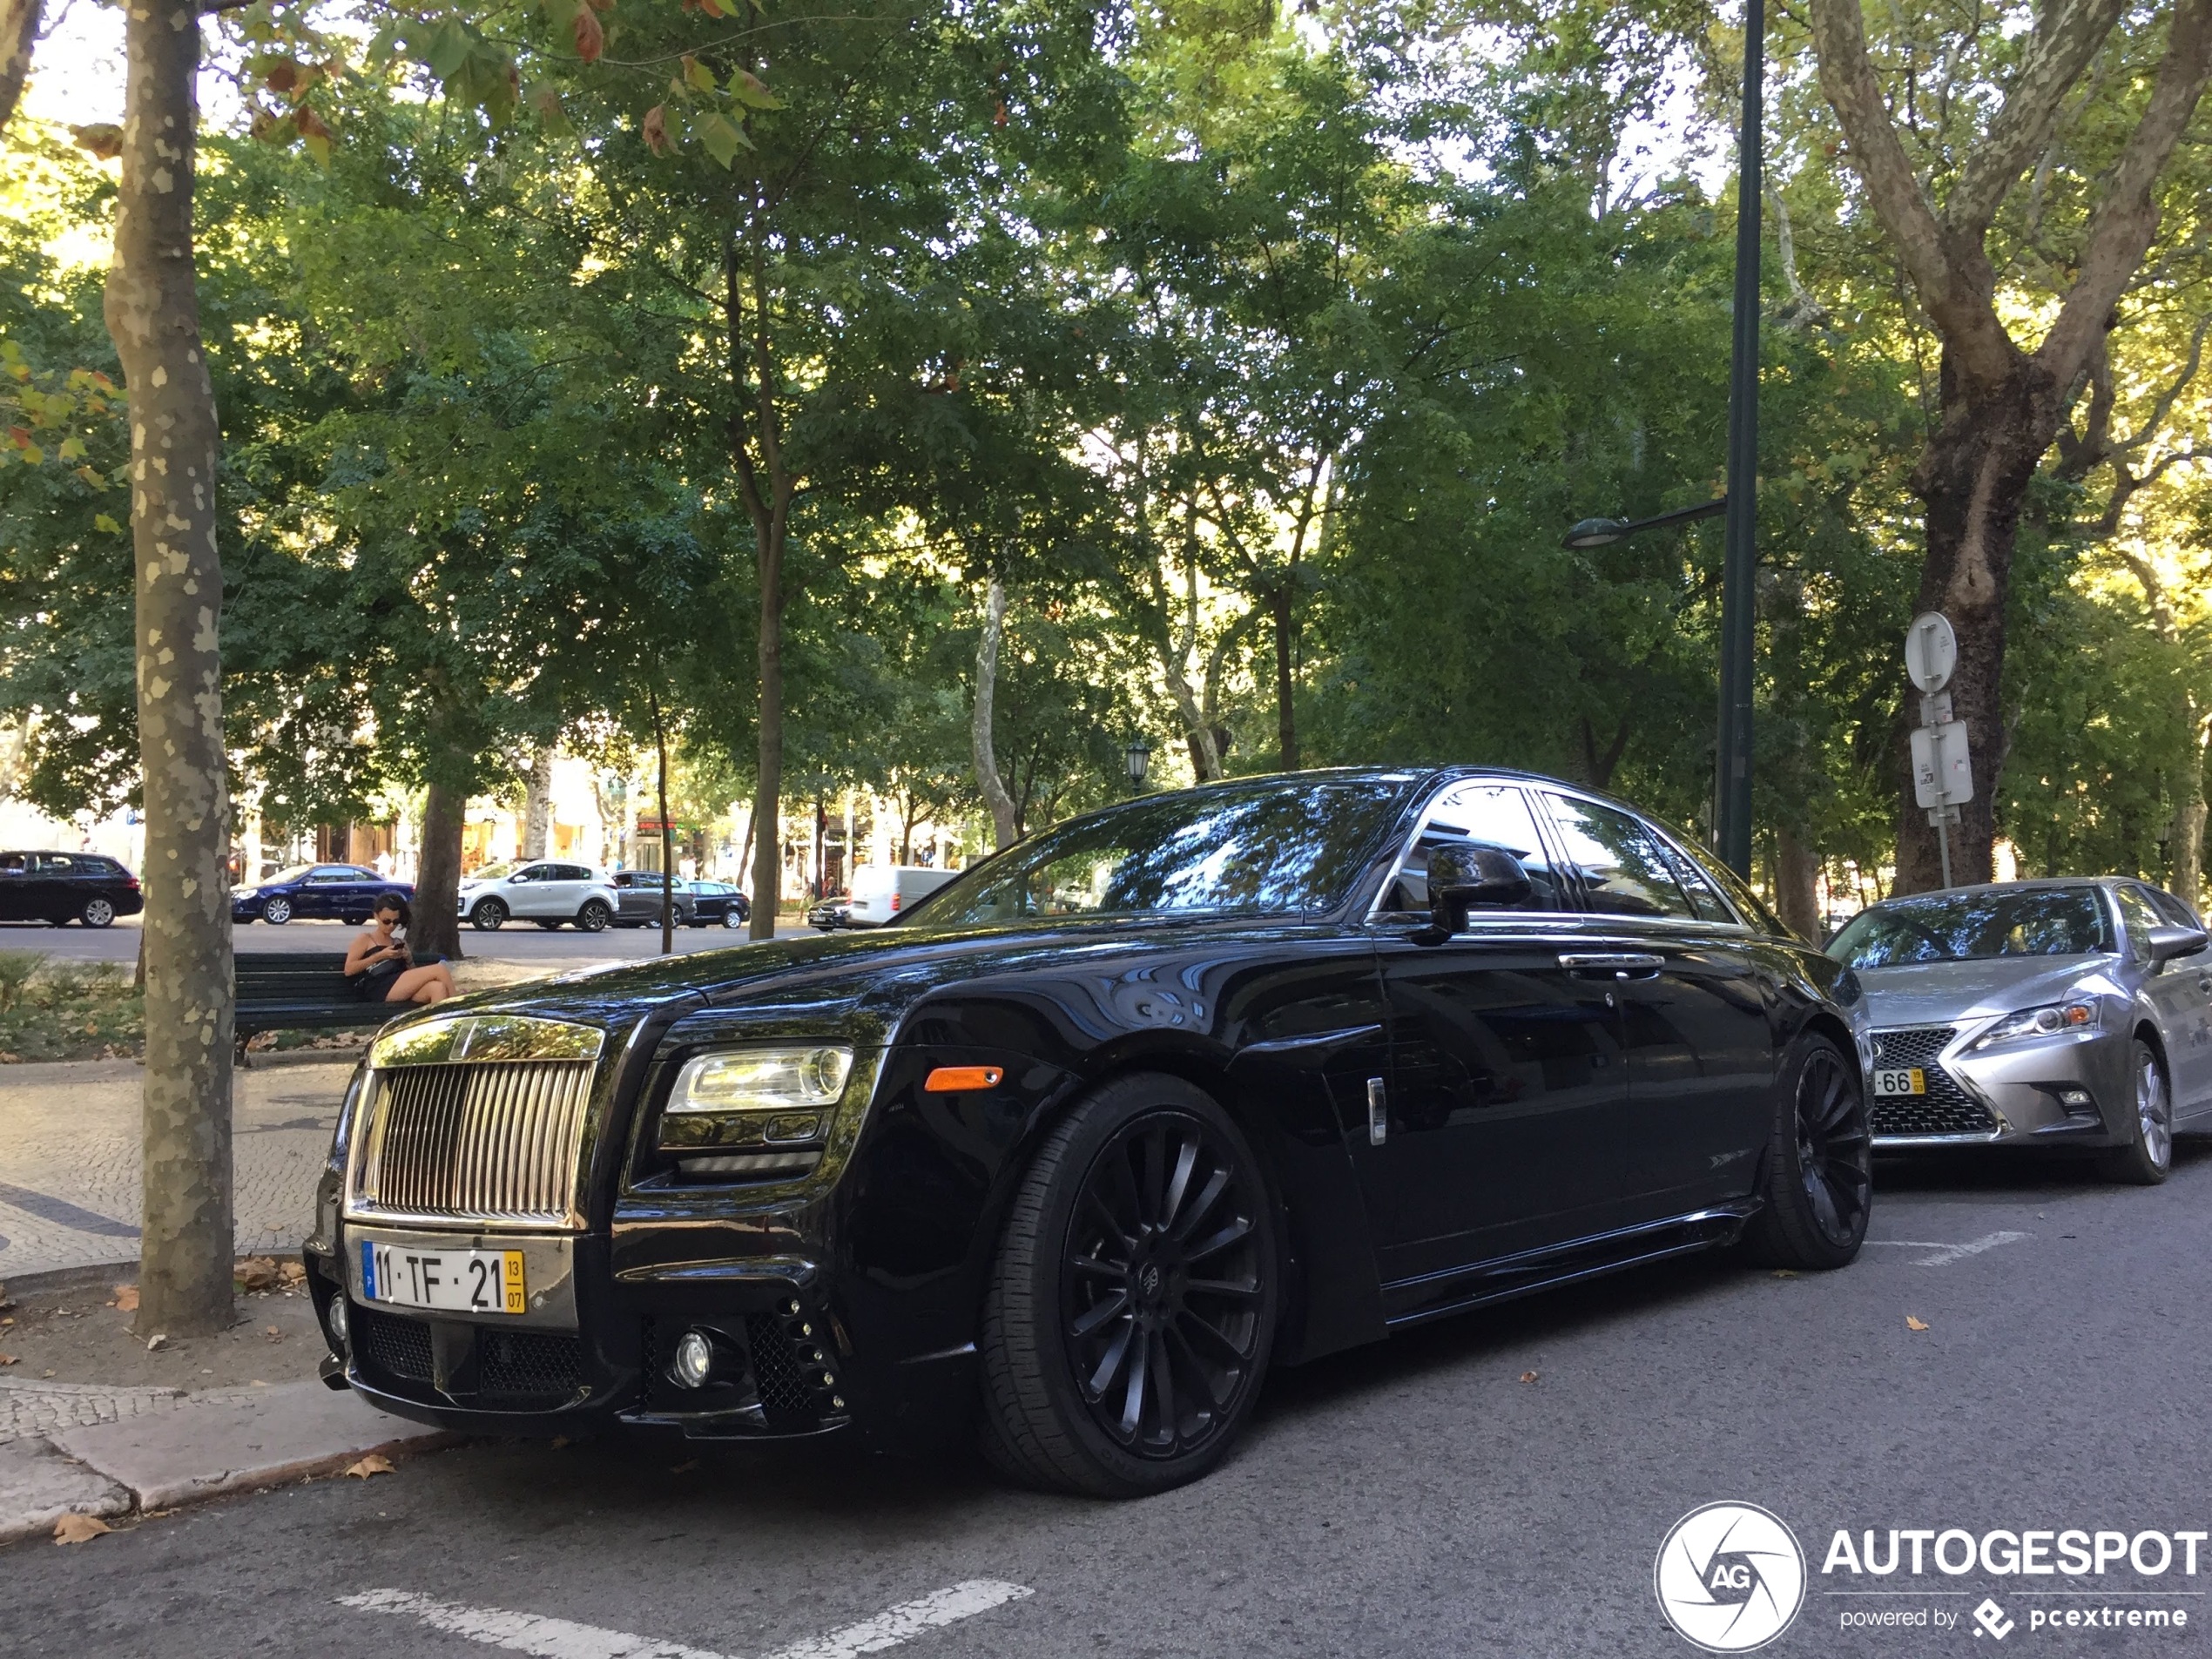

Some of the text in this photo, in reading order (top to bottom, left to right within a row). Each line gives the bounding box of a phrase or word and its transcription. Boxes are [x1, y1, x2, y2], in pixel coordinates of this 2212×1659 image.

[508, 1260, 519, 1277] 13
[367, 1275, 372, 1288] P
[508, 1292, 522, 1308] 07
